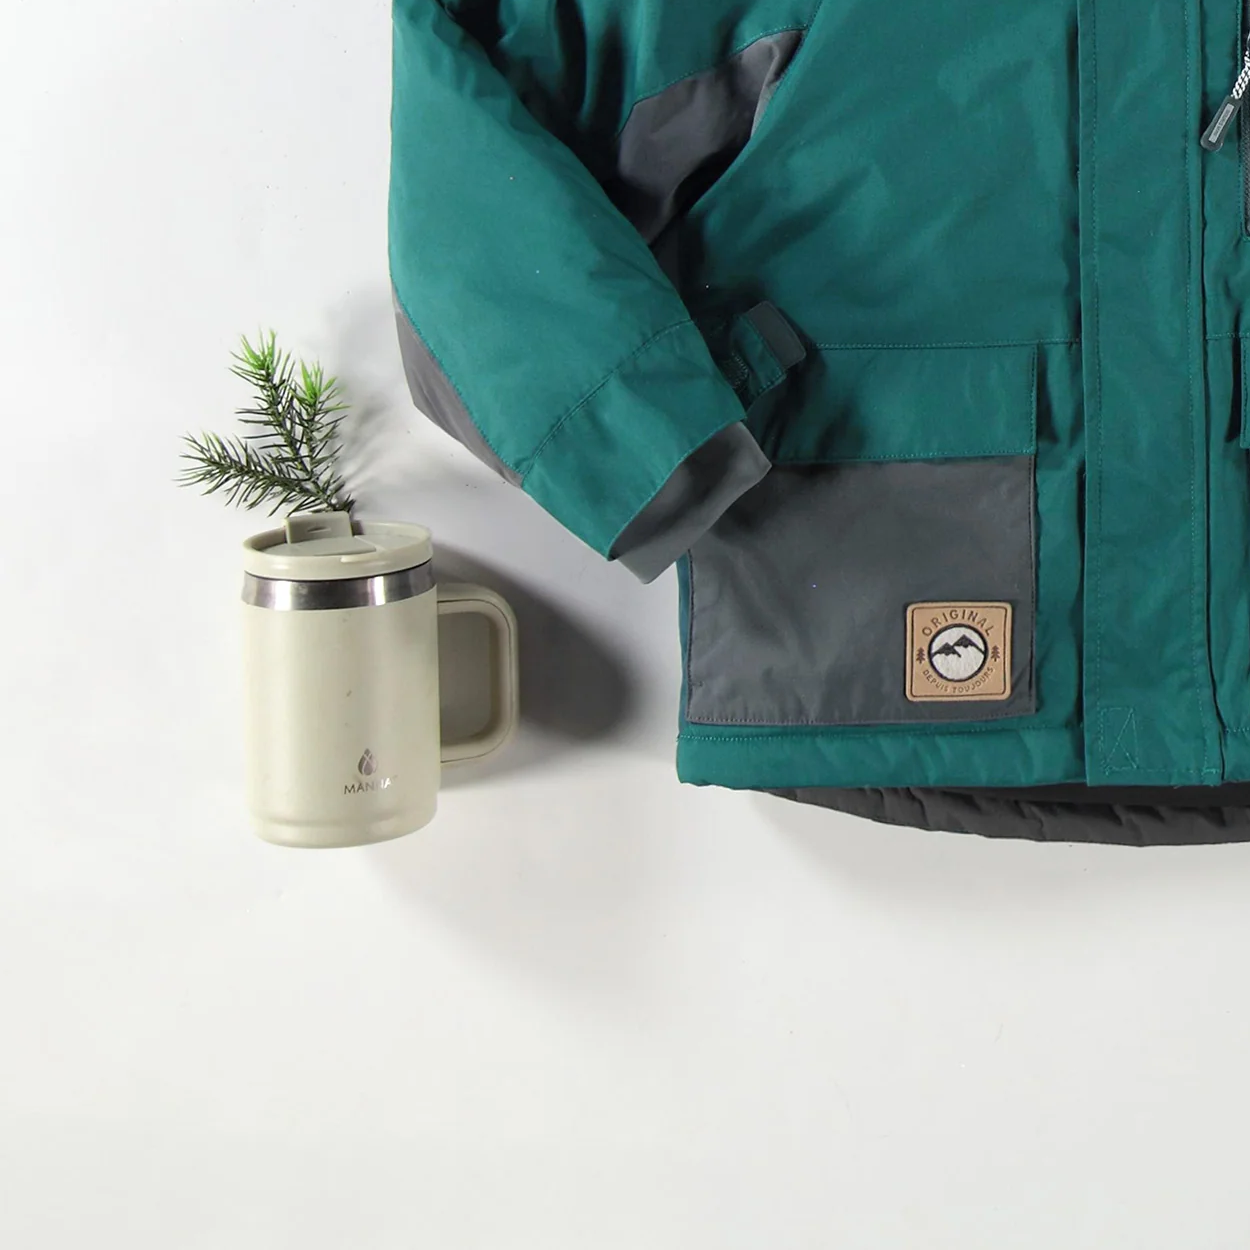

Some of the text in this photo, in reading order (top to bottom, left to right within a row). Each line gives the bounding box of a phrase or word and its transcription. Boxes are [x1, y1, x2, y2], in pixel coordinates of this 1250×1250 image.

[922, 609, 994, 637] ORIGINAL
[922, 666, 994, 694] DEPUIS TOUJOURS
